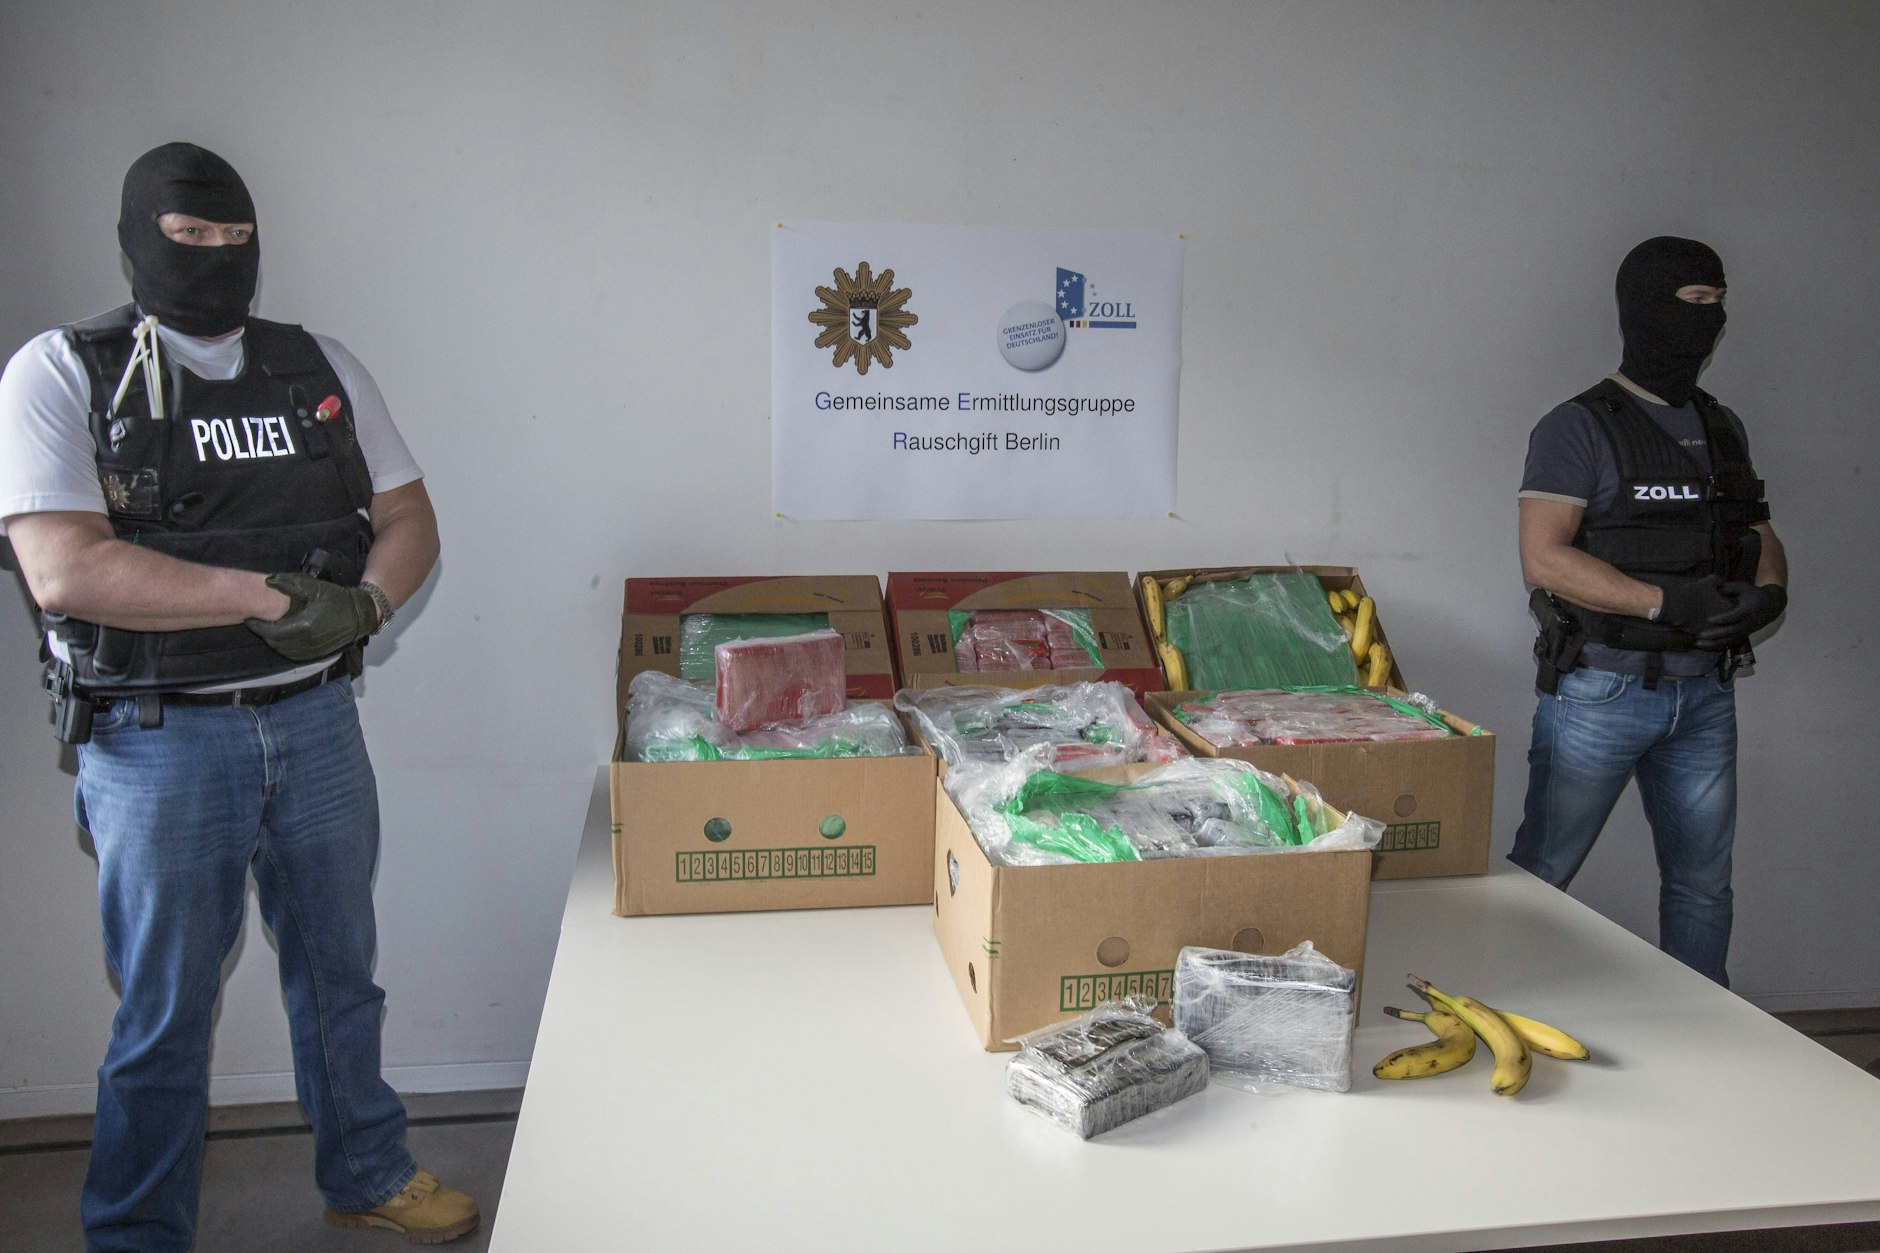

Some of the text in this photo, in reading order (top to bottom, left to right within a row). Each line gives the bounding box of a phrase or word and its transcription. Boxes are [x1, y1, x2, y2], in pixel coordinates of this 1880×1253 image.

[1089, 302, 1136, 318] ZOLL
[1003, 318, 1055, 335] GRENZENLOSER
[1009, 327, 1051, 341] EINSATZ FÜR
[1006, 332, 1059, 349] DEUTSCHLAND!
[814, 391, 1136, 416] Gemeinsame Ermittlungsgruppe
[190, 415, 296, 462] POLIZEI
[893, 431, 1060, 455] Rauschgift Berlin
[1633, 485, 1700, 500] ZOLL
[680, 851, 872, 875] 1 2 3 4 5 6 7 8 9 10 11 12 13 14 15
[1065, 983, 1073, 1004] 1
[1081, 982, 1090, 1003] 2
[1097, 981, 1106, 1002] 3
[1113, 980, 1123, 1001] 4
[1161, 977, 1170, 997] 7
